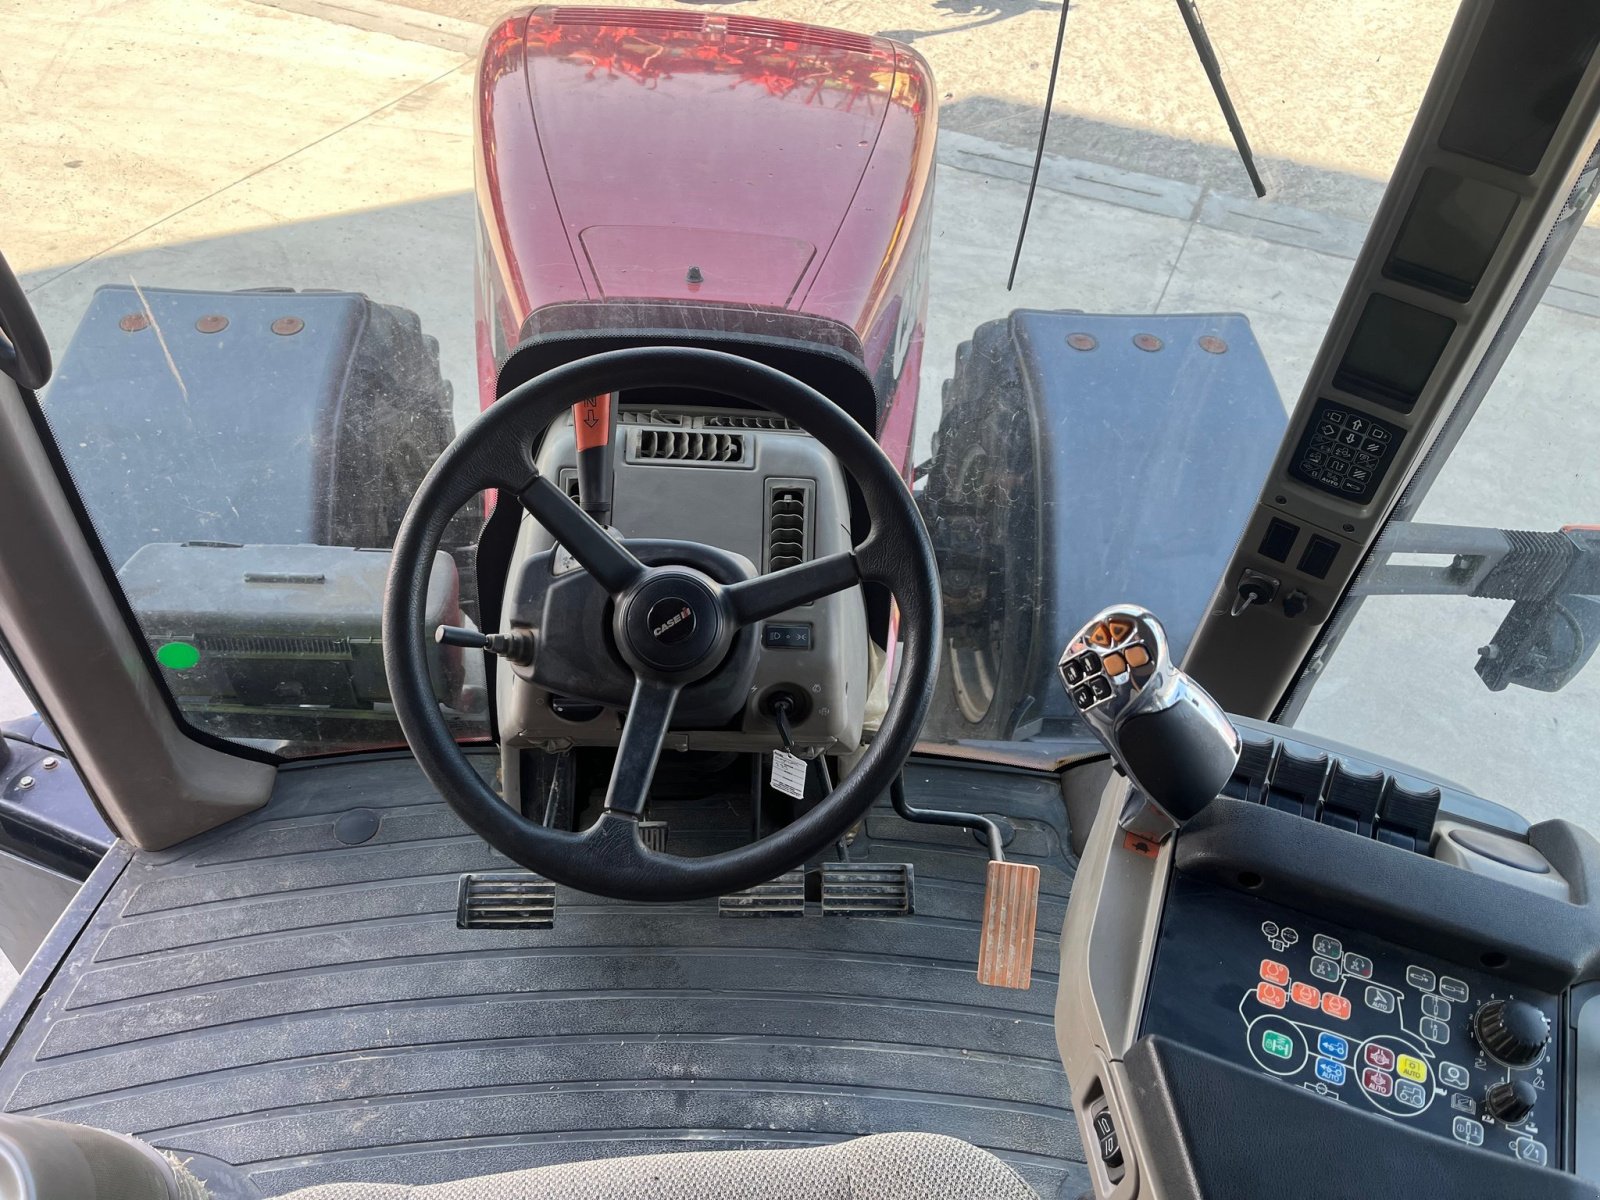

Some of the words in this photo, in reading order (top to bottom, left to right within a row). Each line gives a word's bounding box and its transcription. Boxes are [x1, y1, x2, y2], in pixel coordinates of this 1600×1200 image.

[1321, 477, 1339, 487] AUTO
[653, 613, 682, 637] CASE
[1372, 1001, 1388, 1010] AUTO
[1321, 1071, 1340, 1083] AUTO
[1403, 1069, 1421, 1080] AUTO
[1368, 1082, 1387, 1094] AUTO
